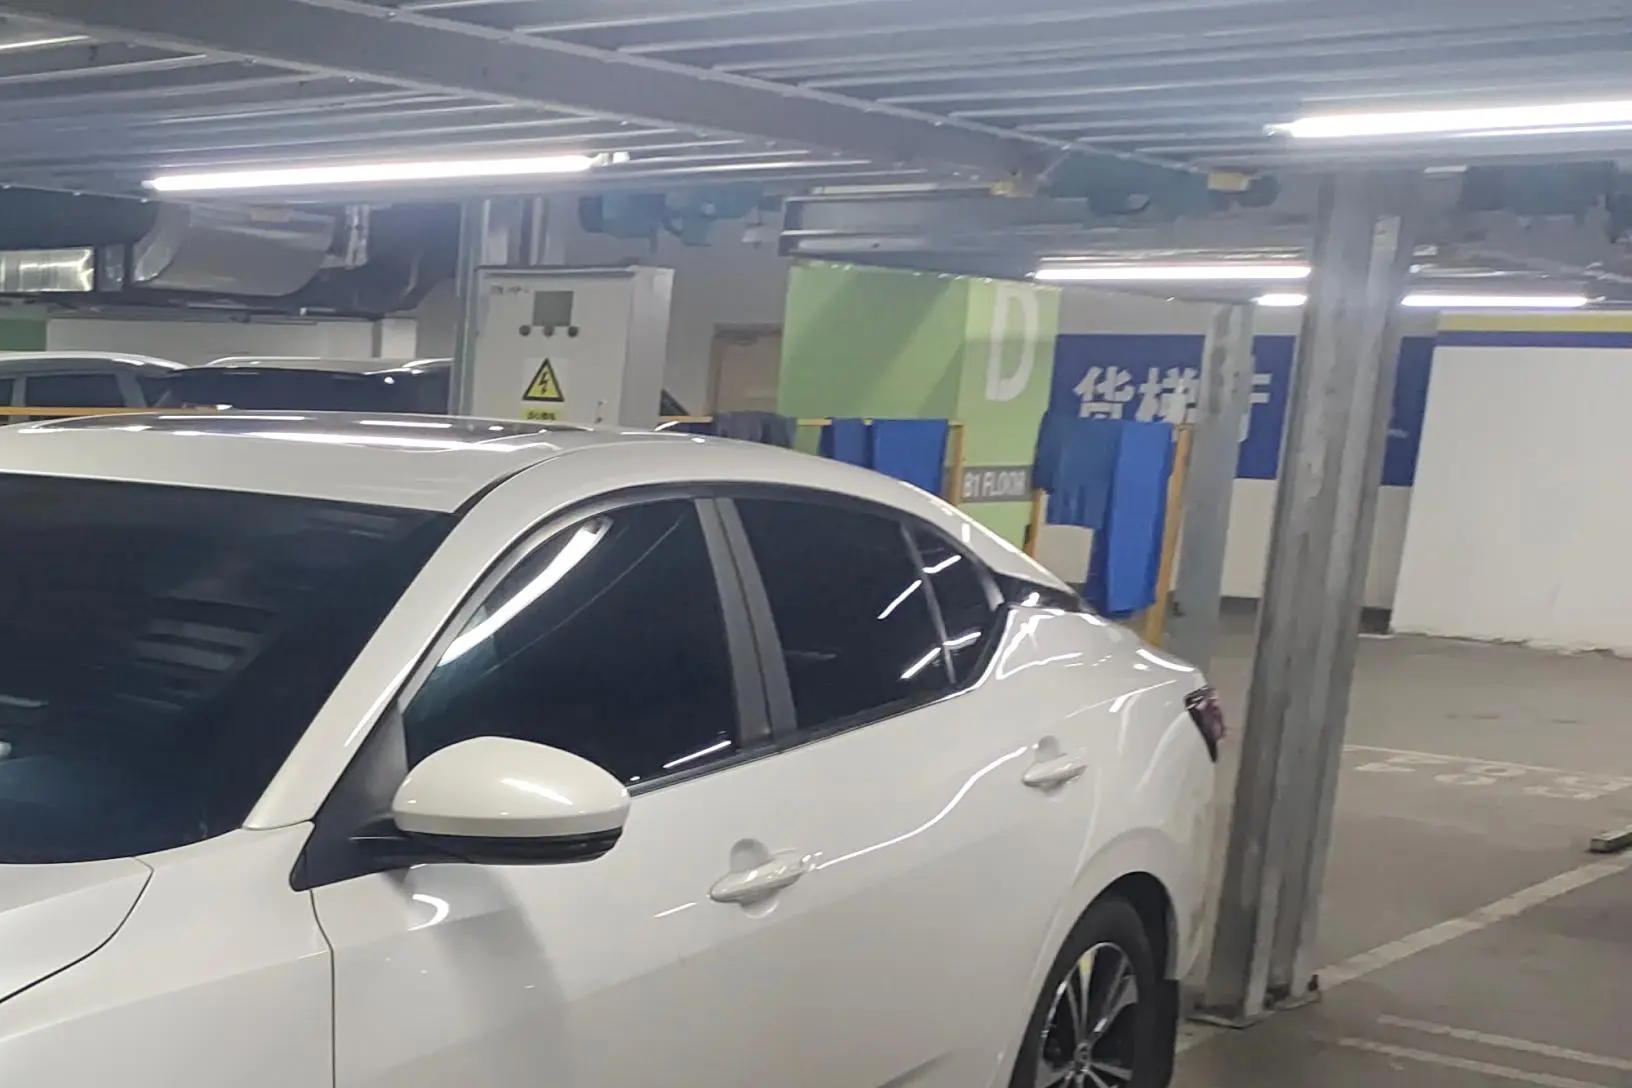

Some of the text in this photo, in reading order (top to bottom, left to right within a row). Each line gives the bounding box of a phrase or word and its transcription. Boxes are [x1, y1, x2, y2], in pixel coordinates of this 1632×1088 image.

[986, 284, 1038, 401] D
[963, 471, 1025, 497] B1 FLOOR
